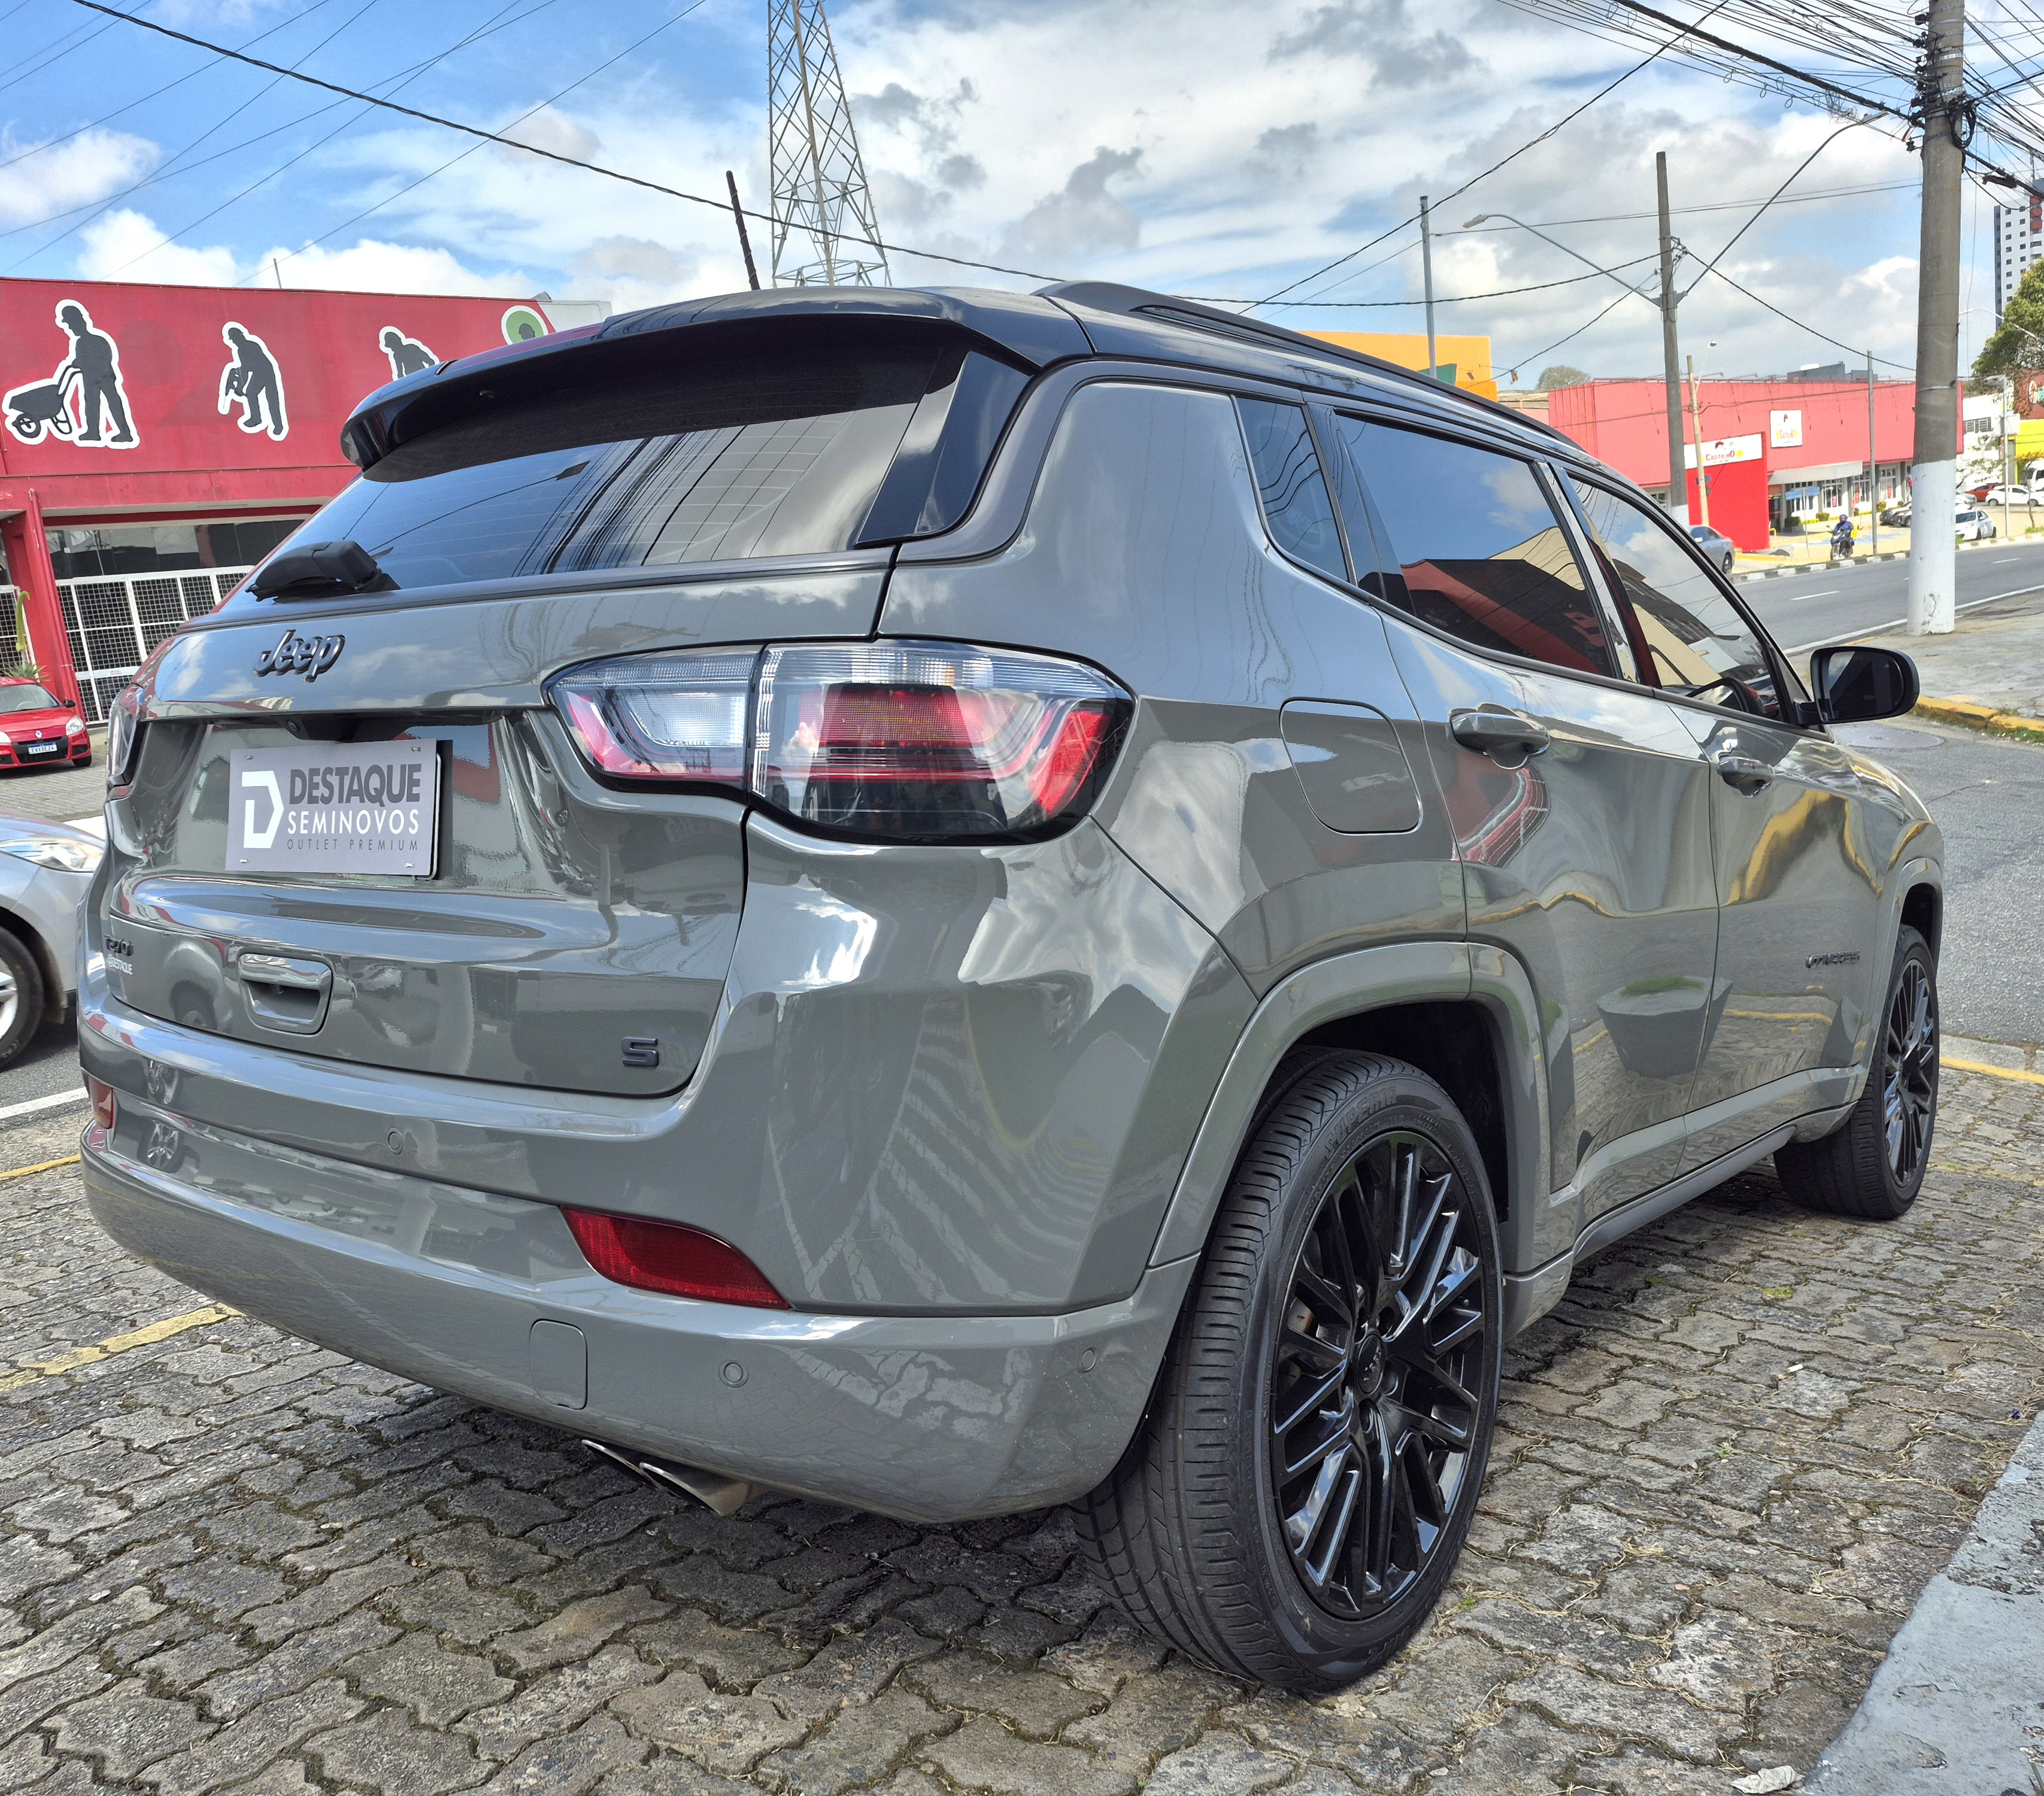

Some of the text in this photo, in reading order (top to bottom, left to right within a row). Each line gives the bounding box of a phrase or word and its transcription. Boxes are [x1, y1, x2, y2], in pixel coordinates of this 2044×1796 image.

[1706, 450, 1735, 462] CASTILHO
[253, 629, 345, 683] Jeep
[289, 763, 421, 807] DESTAQUE
[287, 809, 419, 835] SEMINOVOS
[287, 839, 418, 851] OUTLET PREMIUM
[622, 1036, 659, 1066] S
